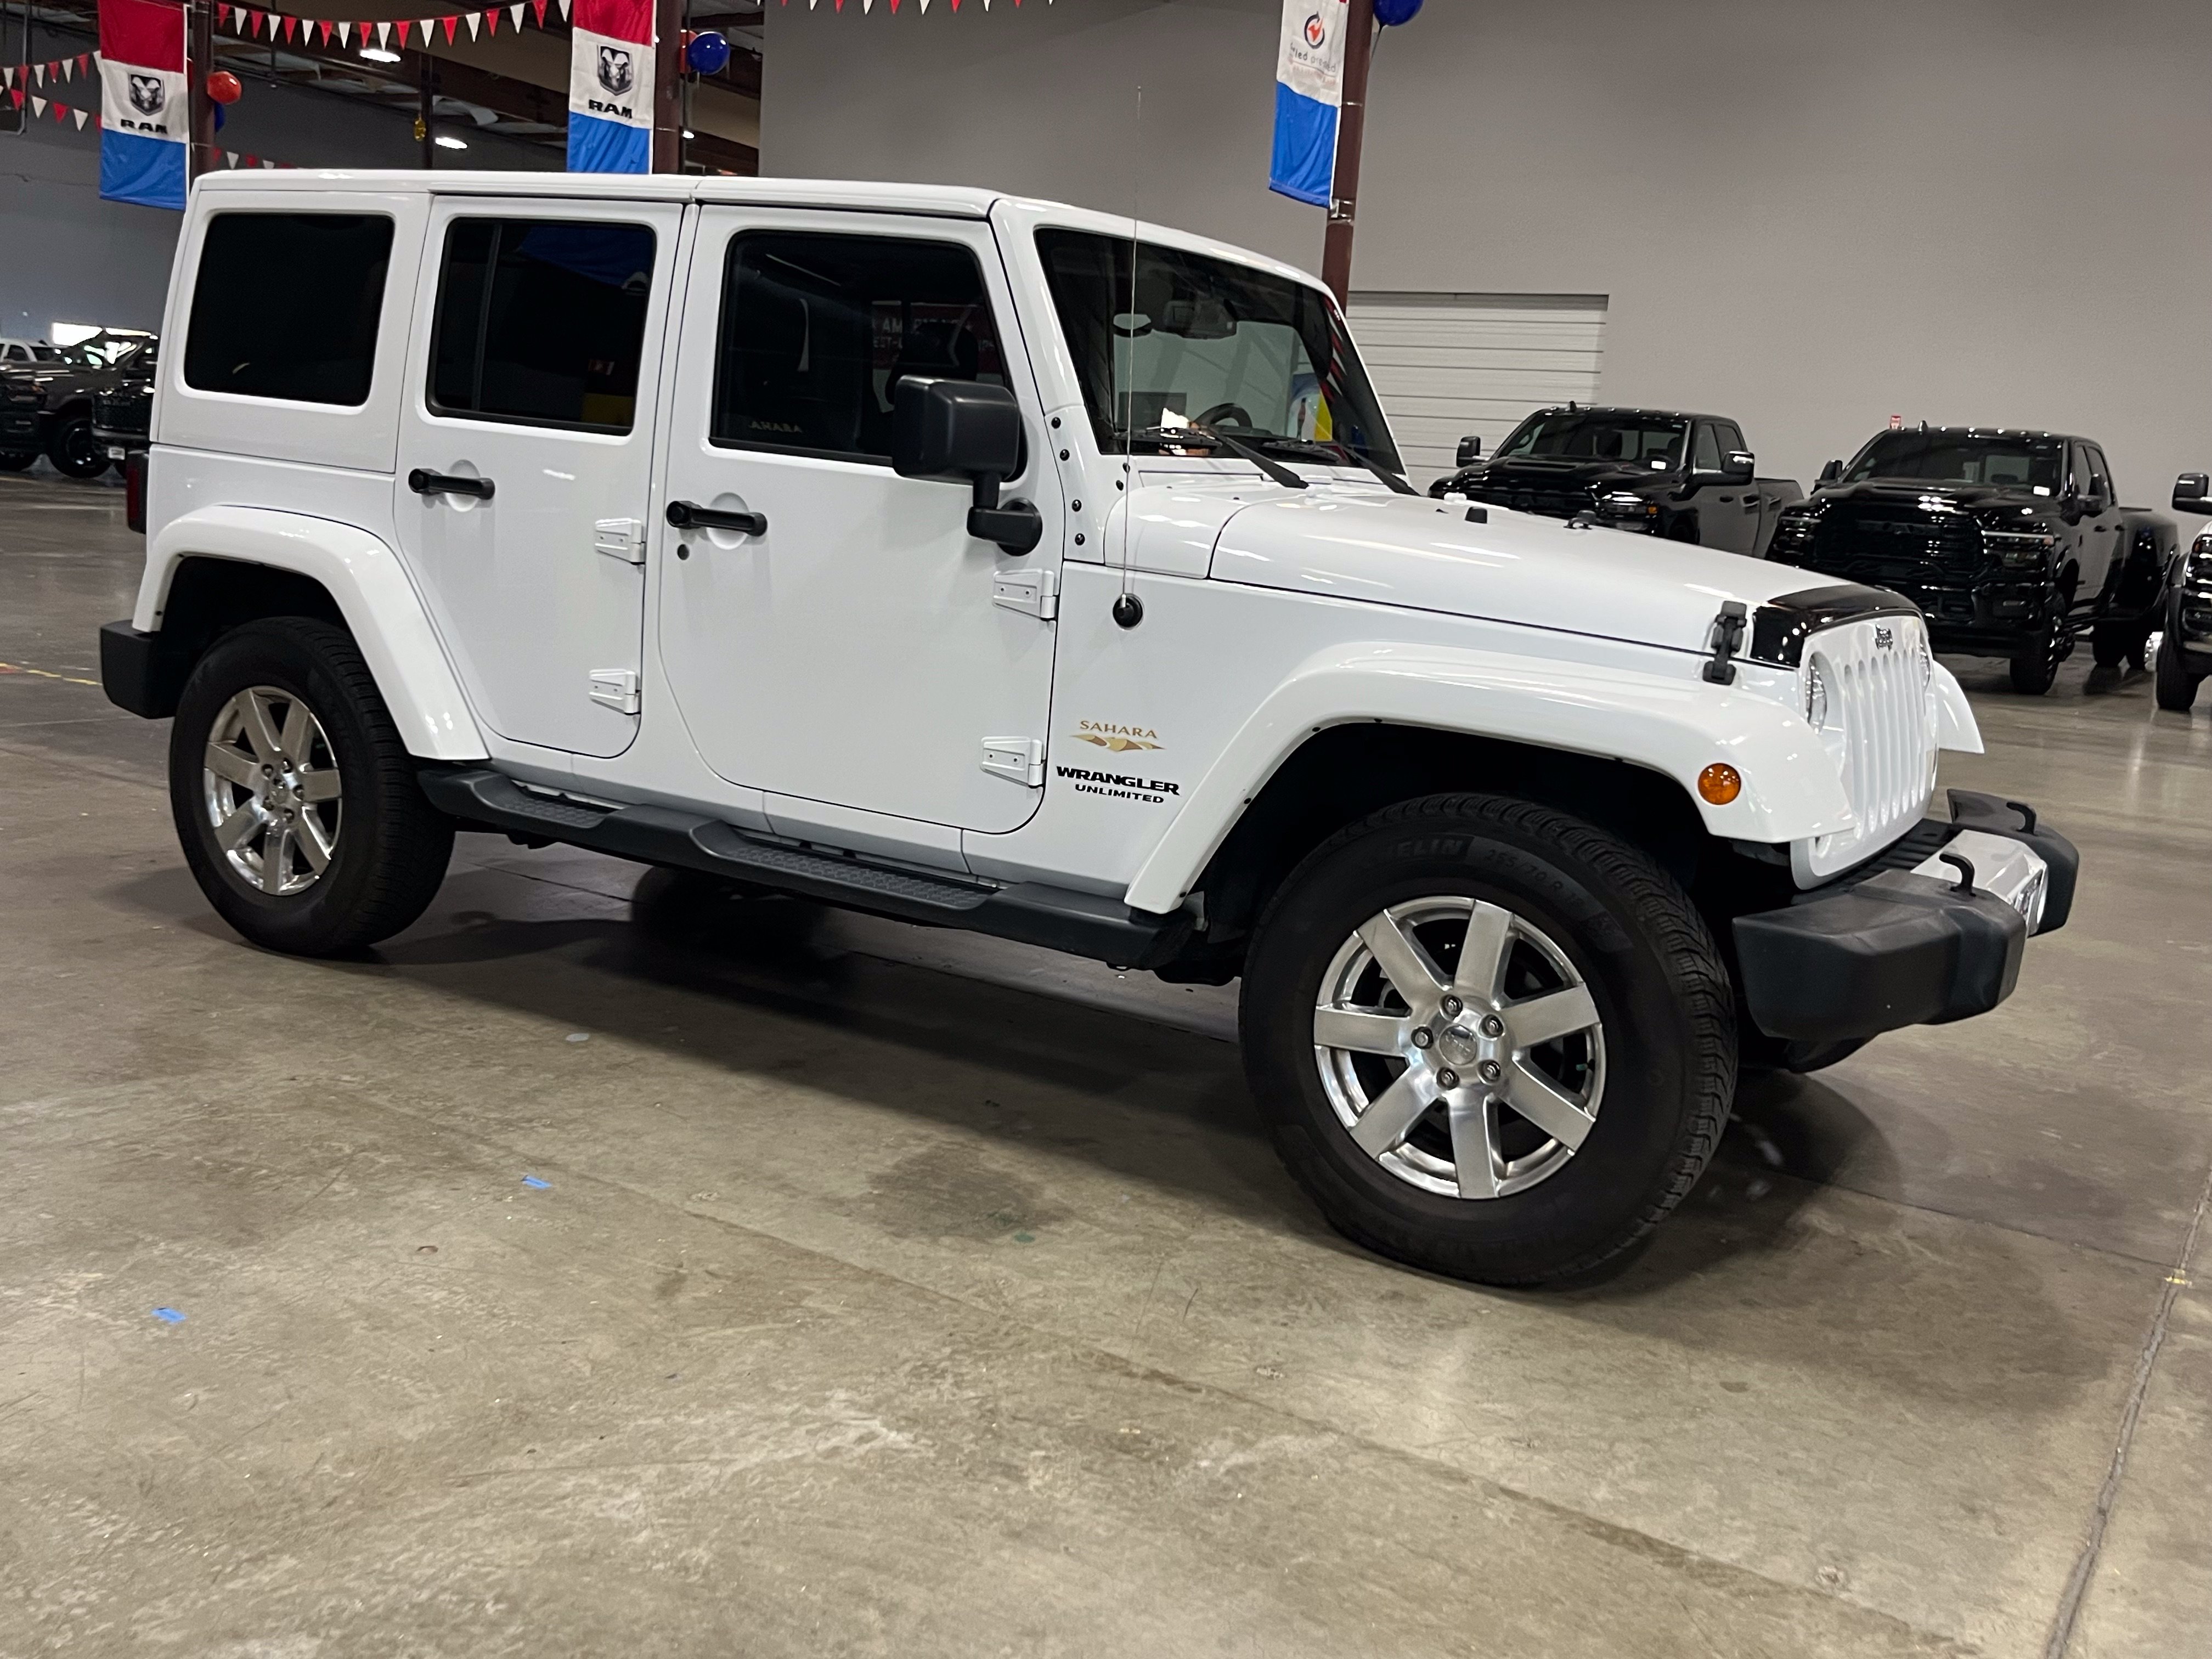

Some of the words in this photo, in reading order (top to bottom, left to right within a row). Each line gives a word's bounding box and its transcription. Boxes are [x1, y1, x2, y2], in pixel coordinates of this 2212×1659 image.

[589, 99, 632, 118] RAM
[121, 119, 167, 134] RAM
[748, 421, 802, 433] AHARA
[1080, 720, 1158, 738] SAHARA
[1056, 766, 1180, 795] WRANGLER
[1075, 784, 1164, 803] UNLIMITED
